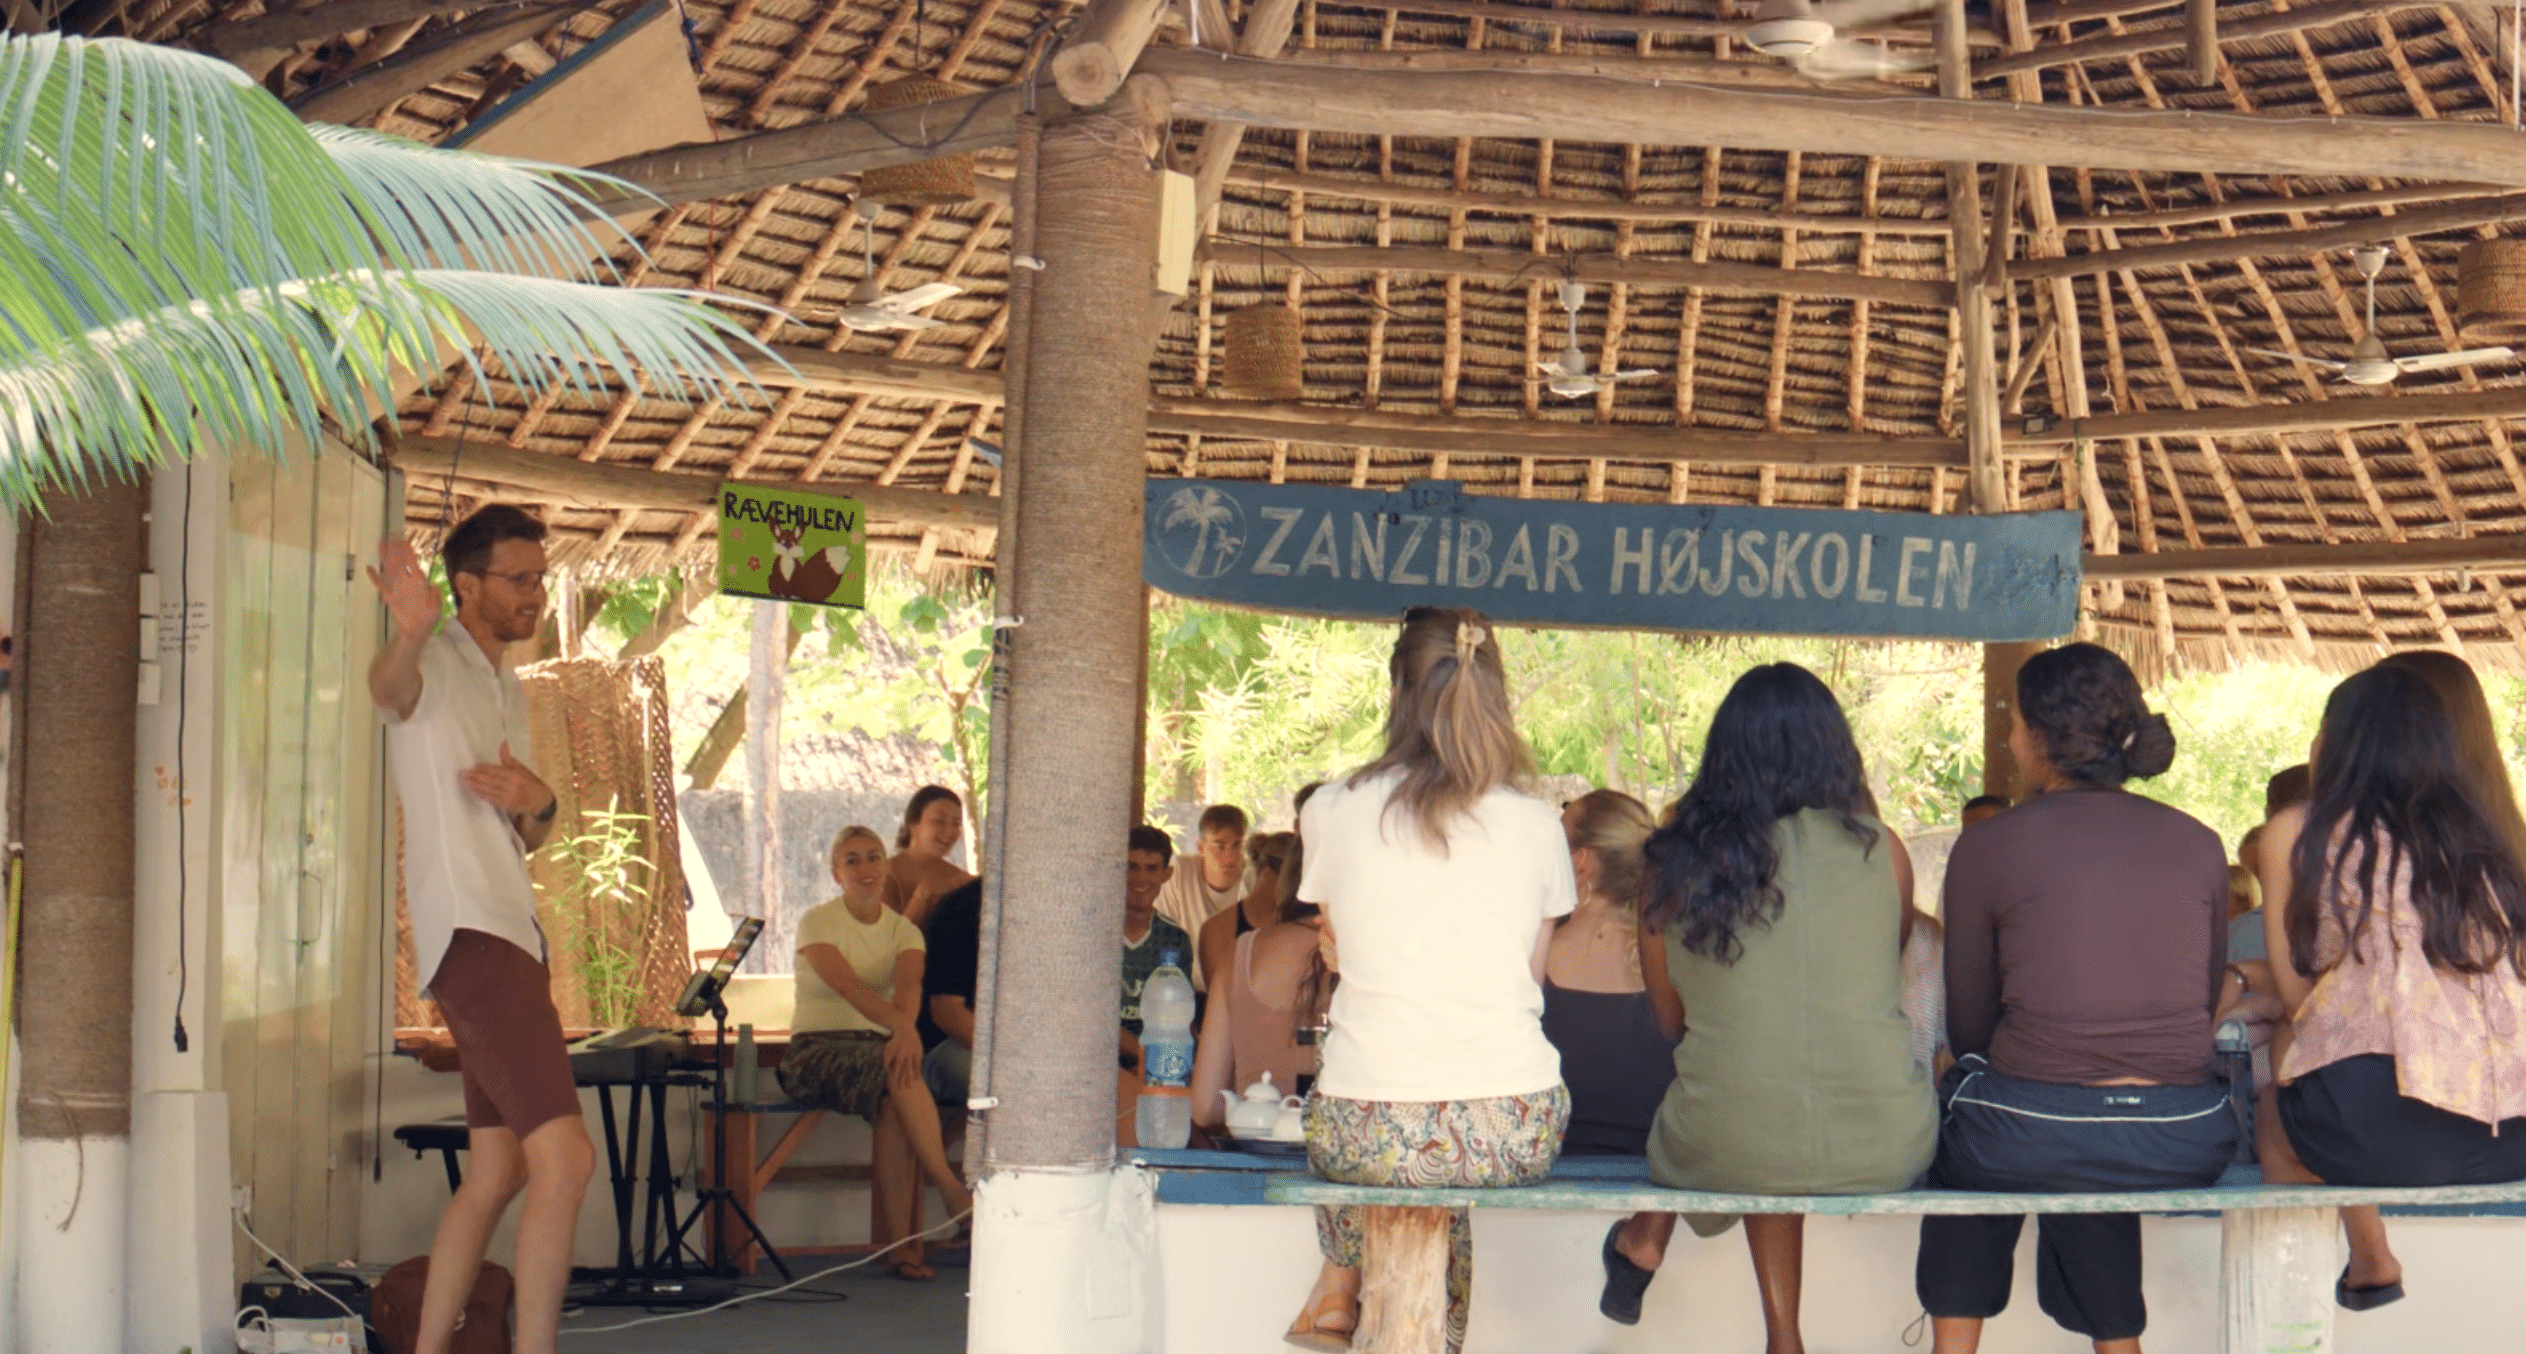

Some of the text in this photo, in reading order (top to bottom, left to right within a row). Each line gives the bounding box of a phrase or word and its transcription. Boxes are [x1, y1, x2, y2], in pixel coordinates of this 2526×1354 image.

[724, 491, 855, 532] RÆVEHULEN
[1250, 506, 1977, 612] ZANZIBAR HØJSKOLEN
